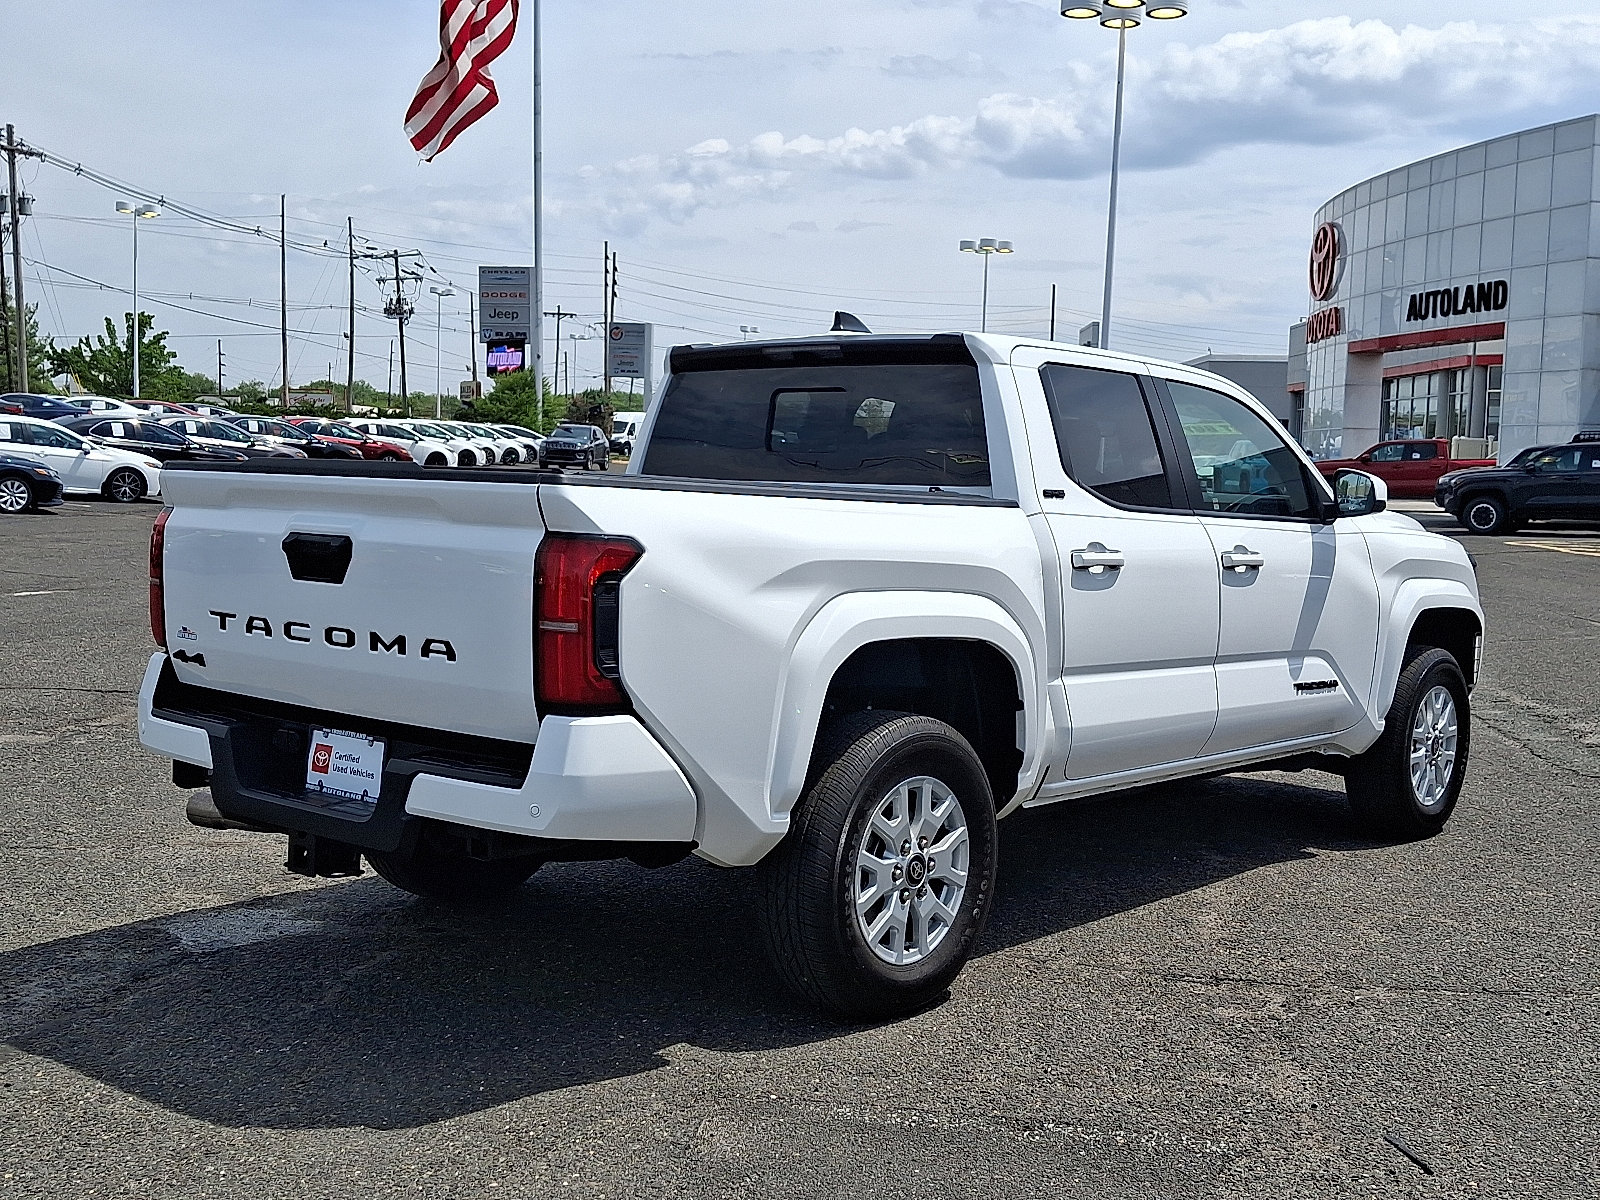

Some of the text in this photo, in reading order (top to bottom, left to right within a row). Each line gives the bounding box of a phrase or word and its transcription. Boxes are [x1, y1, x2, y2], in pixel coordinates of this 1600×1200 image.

[481, 291, 527, 299] DODGE
[1406, 280, 1508, 322] AUTOLAND
[488, 308, 519, 321] Jeep
[494, 331, 527, 339] RAM
[487, 351, 522, 367] AUTOLAND
[208, 610, 457, 663] TACOMA
[334, 751, 361, 764] Certified
[332, 763, 375, 780] Used Vehicles
[322, 787, 362, 800] AUTOLAND
